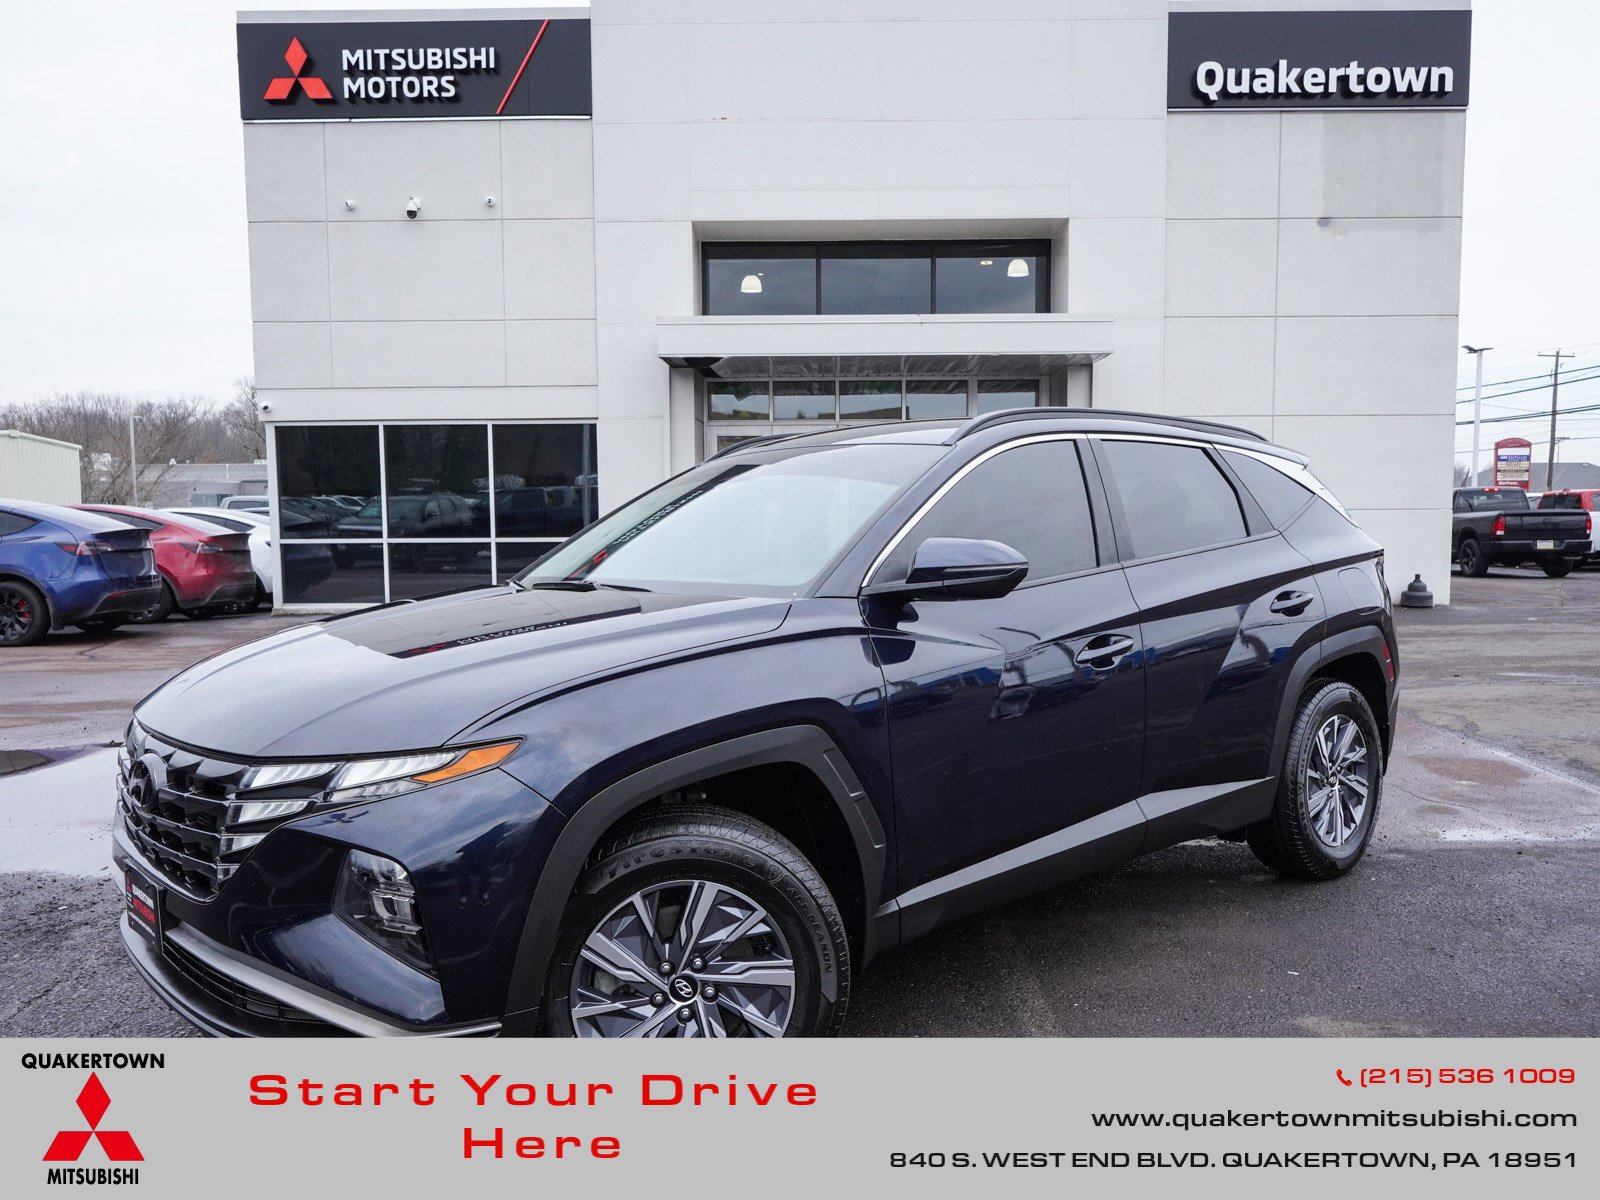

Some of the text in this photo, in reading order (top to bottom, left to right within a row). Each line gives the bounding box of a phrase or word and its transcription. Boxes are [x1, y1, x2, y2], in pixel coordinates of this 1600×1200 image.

[341, 46, 495, 71] MITSUBISHI
[343, 75, 456, 99] MOTORS
[1196, 59, 1454, 101] Quakertown
[808, 912, 833, 974] SEASON
